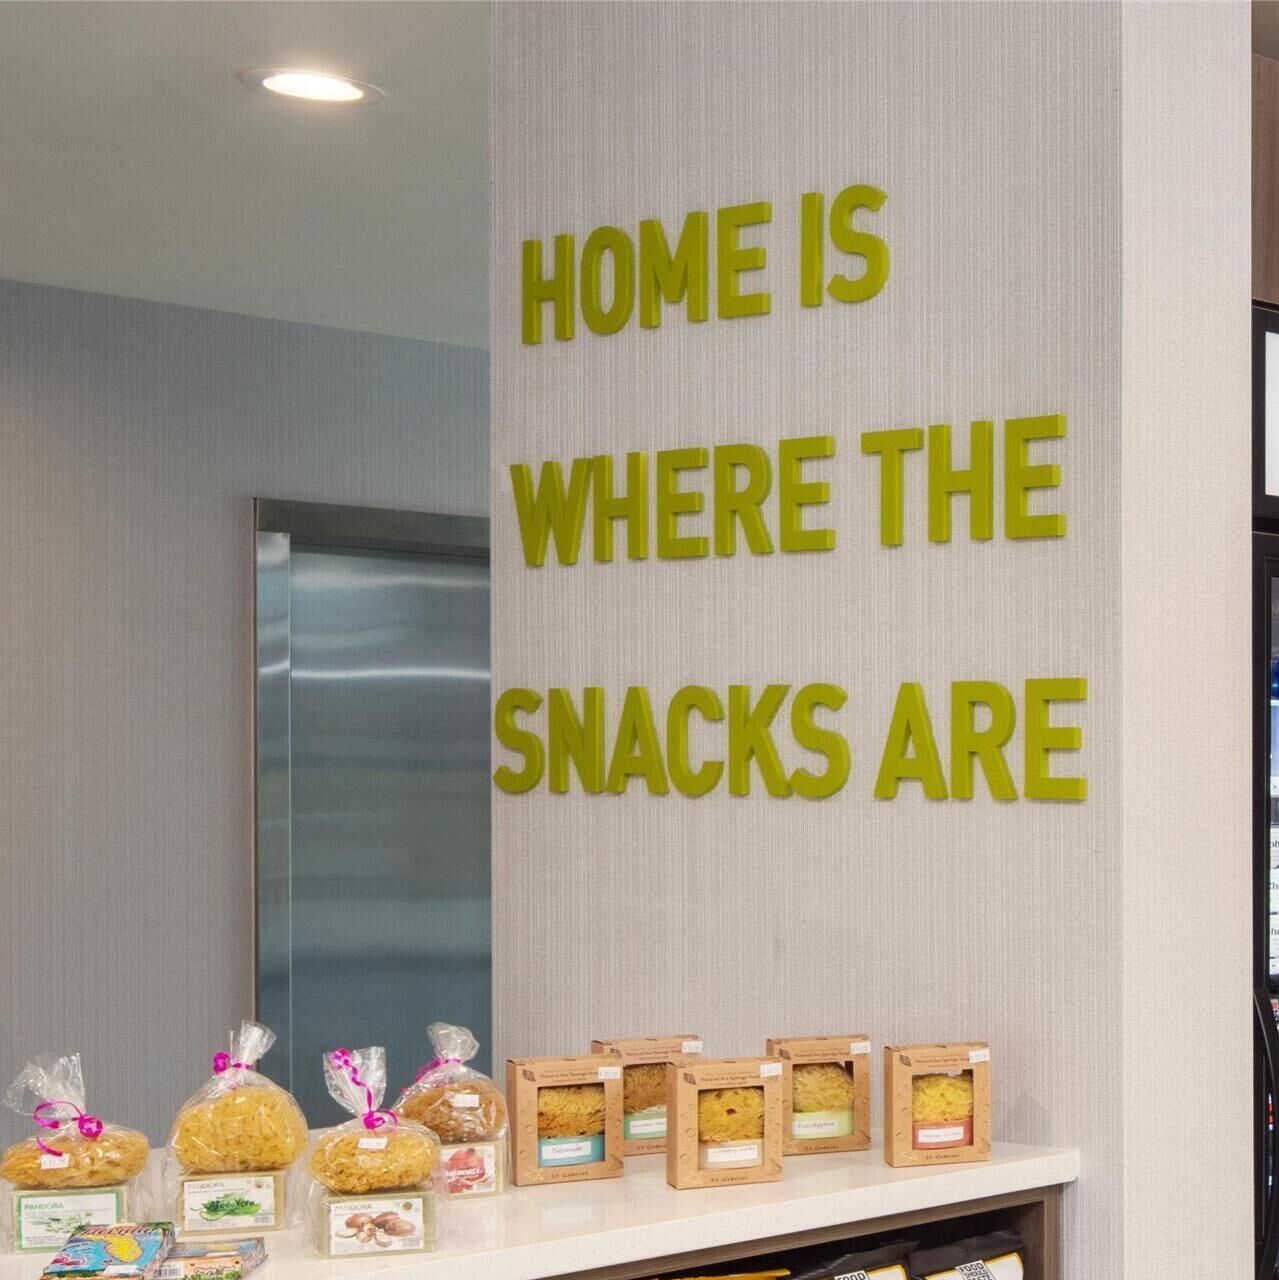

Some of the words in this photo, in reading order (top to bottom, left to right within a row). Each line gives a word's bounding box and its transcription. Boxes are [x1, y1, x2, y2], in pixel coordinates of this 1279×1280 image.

[521, 201, 772, 345] HOME
[801, 183, 891, 308] IS
[510, 435, 836, 567] WHERE
[860, 414, 1067, 547] THE
[492, 682, 851, 800] SNACKS
[873, 677, 1089, 802] ARE
[958, 1262, 985, 1273] FOOD
